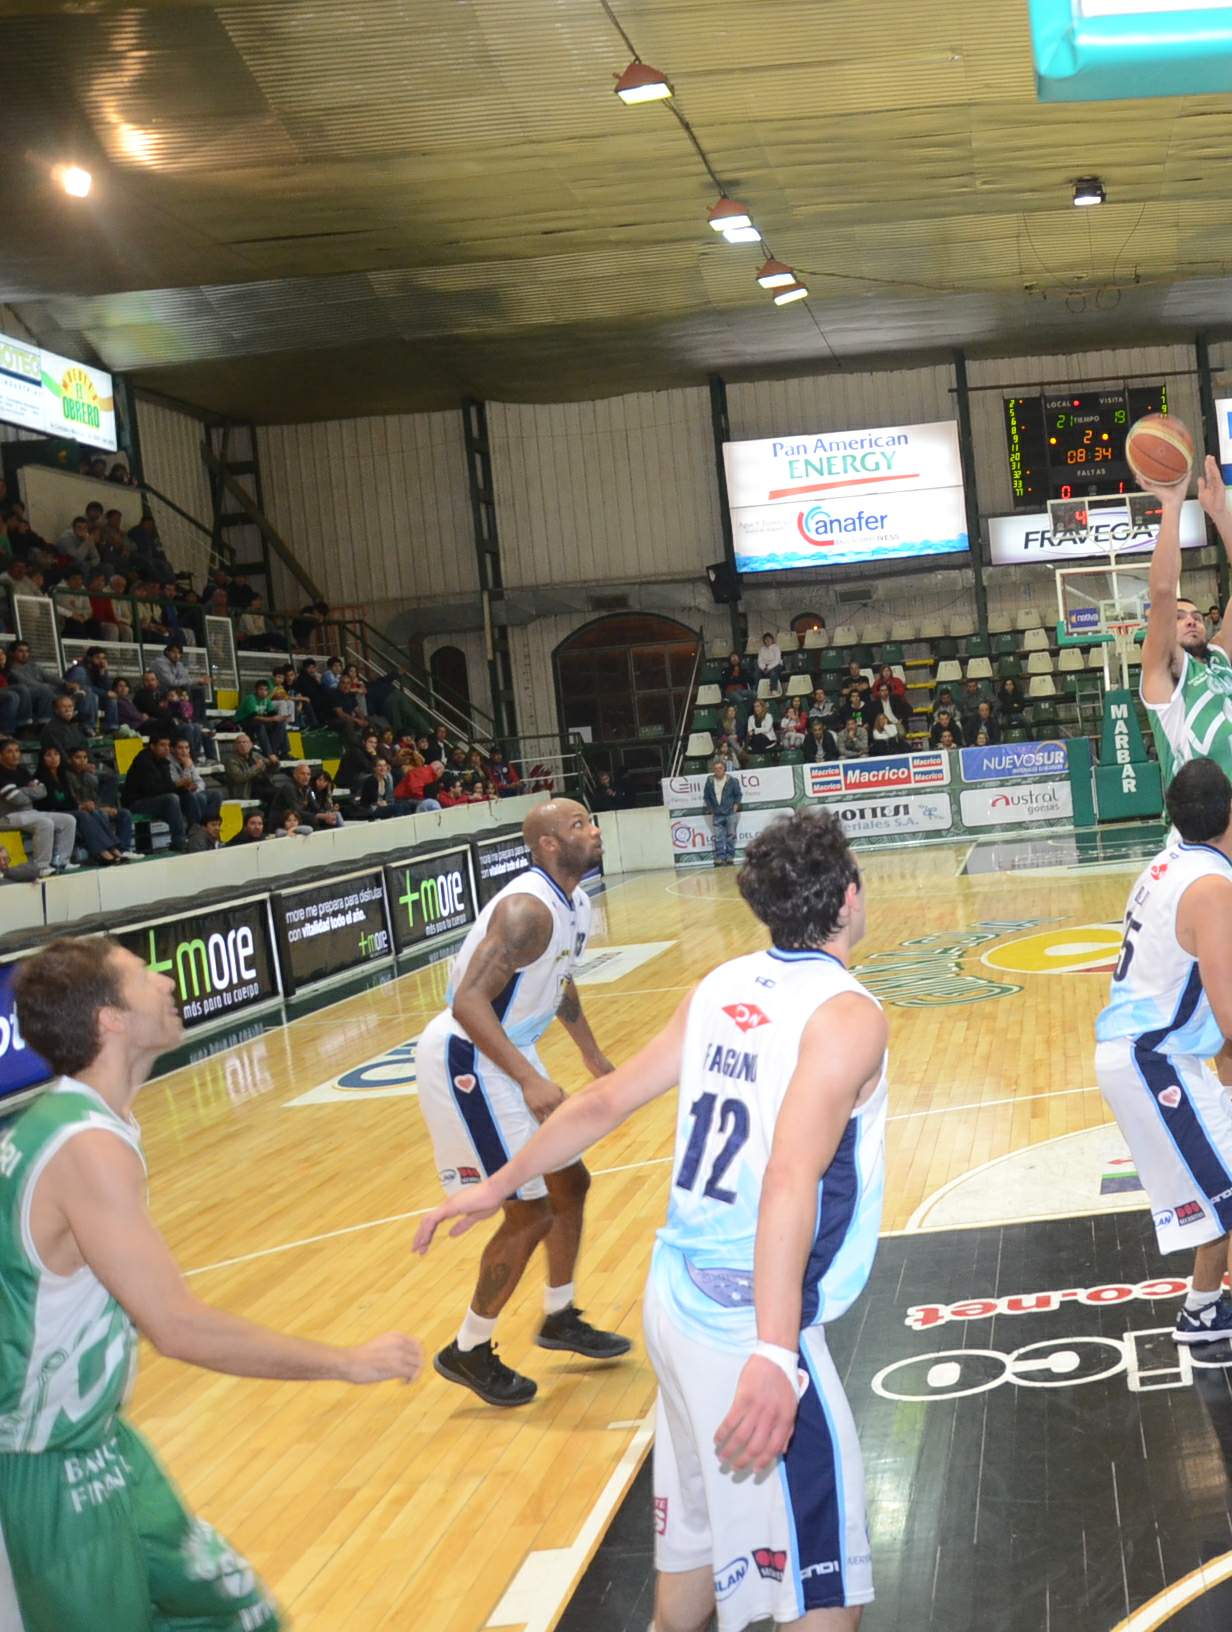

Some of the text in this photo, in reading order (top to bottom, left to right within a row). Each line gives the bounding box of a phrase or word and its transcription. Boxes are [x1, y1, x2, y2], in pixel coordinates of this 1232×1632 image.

[1046, 400, 1071, 408] LOCAL
[1099, 396, 1124, 404] VISITA
[62, 396, 100, 429] OBRERO
[1074, 415, 1100, 423] TIEMPO
[1083, 430, 1093, 444] 2
[772, 433, 909, 457] Pan American
[788, 451, 896, 480] ENERGY
[1076, 468, 1106, 476] FALTAS
[1061, 485, 1072, 499] 0
[1111, 704, 1136, 793] MARBAR
[913, 756, 942, 765] Macrico
[983, 751, 1064, 771] NUEVOSUR
[811, 768, 840, 777] Macrico
[846, 766, 908, 784] Macrico
[914, 772, 943, 781] Macrico
[813, 783, 841, 791] Macrico
[286, 887, 383, 924] more me prepara para disfrutar
[288, 929, 301, 942] con
[302, 918, 330, 938] vitalidad
[331, 913, 345, 929] todo
[346, 911, 352, 924] el
[426, 925, 436, 936] más
[436, 921, 447, 934] para
[183, 982, 259, 1020] más para tu cuerpo
[676, 1091, 751, 1205] 12
